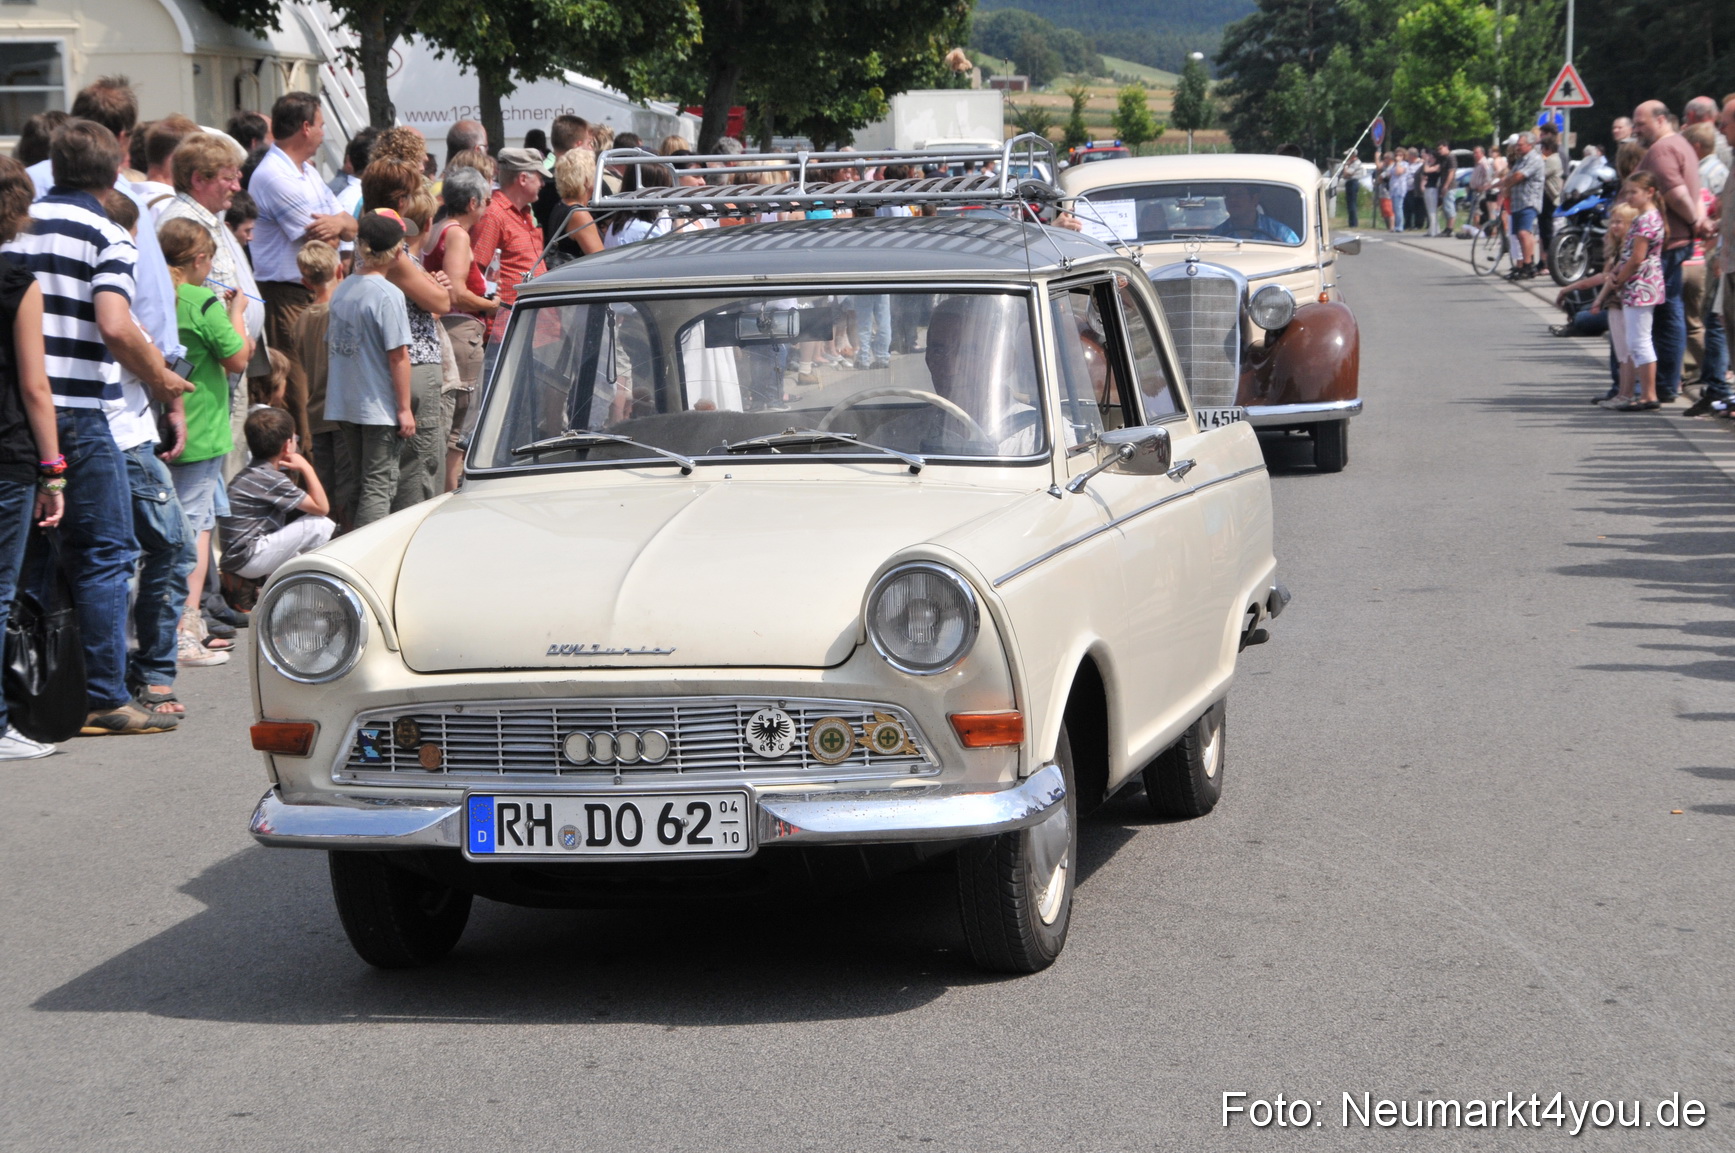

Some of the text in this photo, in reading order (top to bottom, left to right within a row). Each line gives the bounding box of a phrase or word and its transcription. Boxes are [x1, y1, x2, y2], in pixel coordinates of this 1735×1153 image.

[404, 104, 576, 122] www.123chner.de
[1211, 410, 1240, 428] 45H
[719, 800, 738, 813] 04
[497, 802, 554, 847] RH
[584, 802, 643, 847] DO
[656, 801, 713, 846] 62
[477, 830, 487, 843] D
[722, 831, 739, 844] 10
